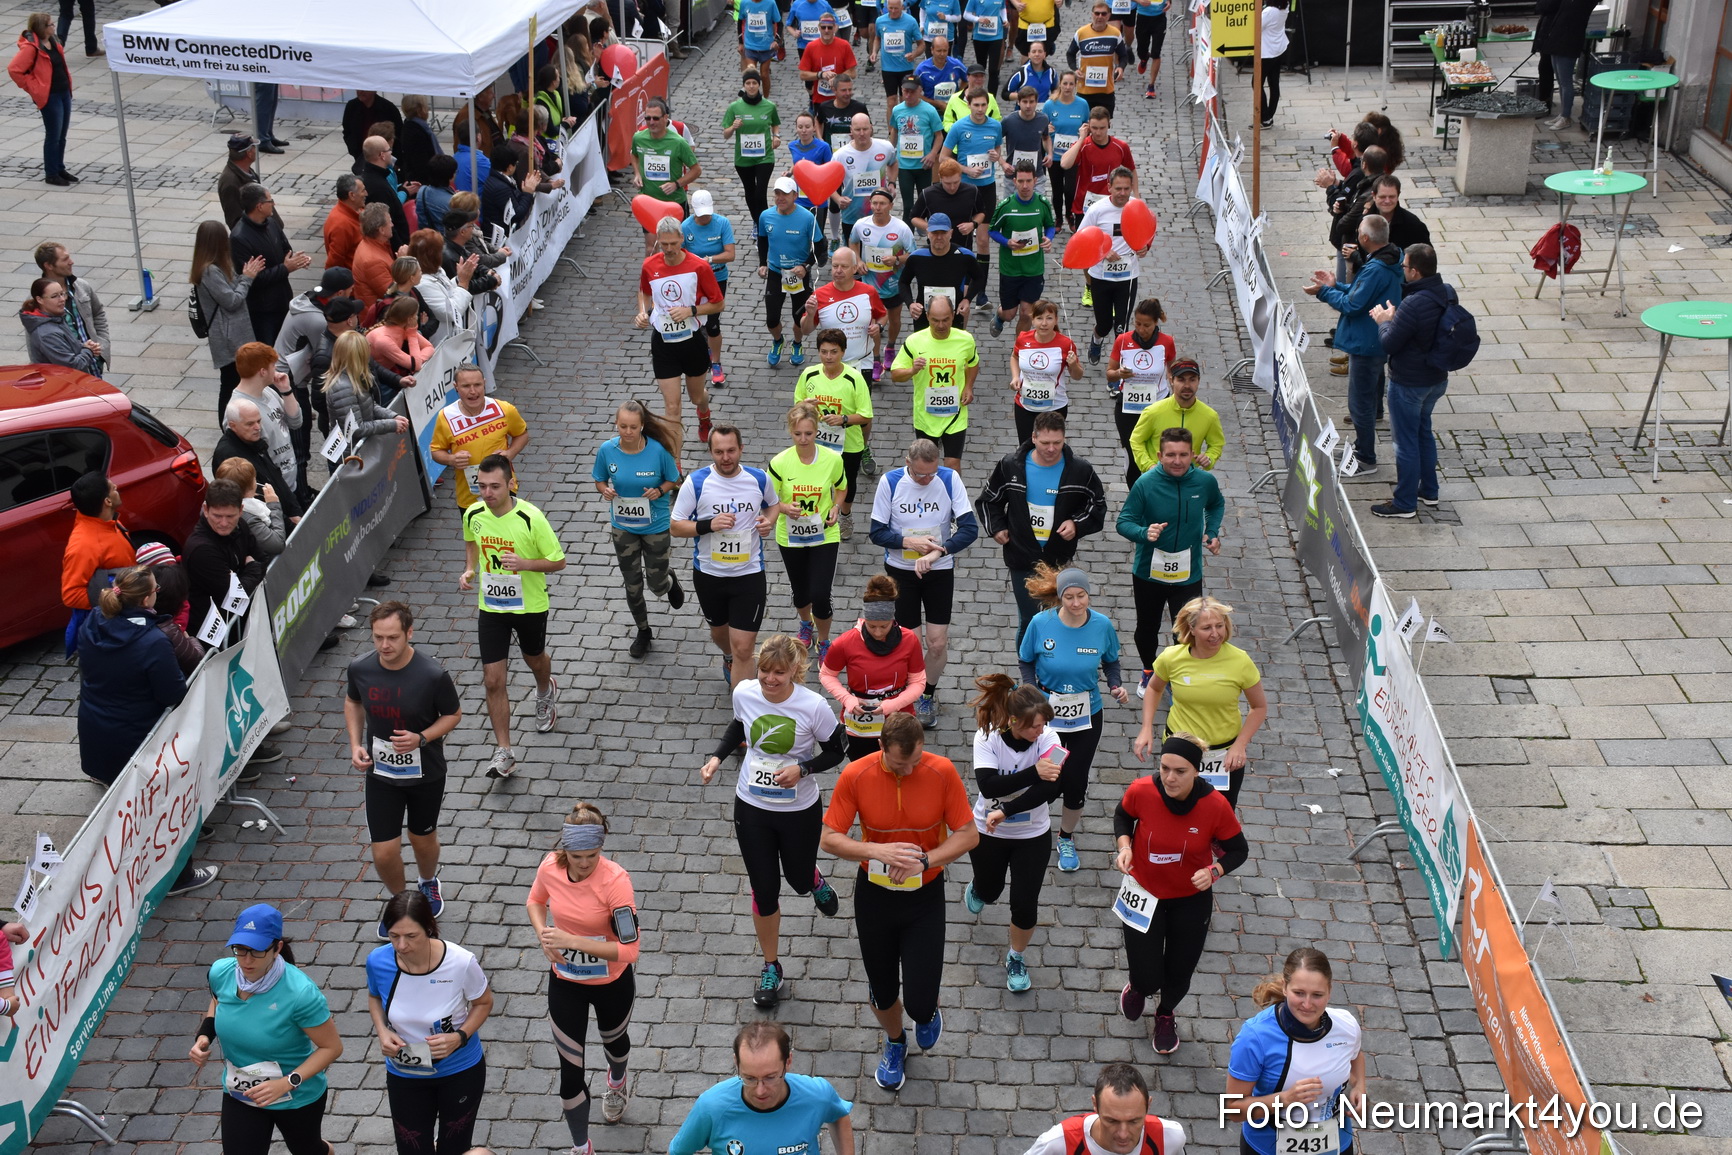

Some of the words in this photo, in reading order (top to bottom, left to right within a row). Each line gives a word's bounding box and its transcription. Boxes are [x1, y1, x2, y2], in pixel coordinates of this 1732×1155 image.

[1213, 2, 1255, 15] Jugend
[1226, 15, 1248, 27] lauf
[122, 34, 170, 52] BMW
[175, 38, 313, 62] ConnectedDrive
[125, 52, 180, 69] Vernetzt,
[182, 60, 201, 68] um
[203, 58, 224, 70] frei
[225, 63, 240, 72] zu
[242, 62, 271, 74] sein.
[647, 163, 666, 172] 2555
[857, 179, 877, 187] 2589
[784, 276, 798, 284] 198
[663, 321, 686, 332] 2173
[1297, 331, 1306, 348] swn
[936, 372, 950, 383] M
[814, 395, 842, 403] Müller
[1026, 389, 1050, 399] 2338
[1128, 392, 1151, 402] 2914
[930, 396, 955, 406] 2598
[455, 432, 479, 446] MAX
[480, 421, 508, 437] BÖGL
[816, 430, 840, 443] 2417
[327, 438, 341, 456] swn
[617, 506, 644, 516] 2440
[712, 498, 754, 514] SUSPA
[900, 498, 940, 518] SUSPA
[791, 524, 818, 535] 2045
[481, 536, 514, 546] Müller
[720, 542, 741, 553] 211
[1163, 562, 1178, 571] 58
[274, 552, 323, 642] BOCK
[487, 584, 516, 597] 2046
[207, 617, 221, 640] swn
[1063, 684, 1075, 693] 18.
[1054, 704, 1085, 717] 2237
[254, 716, 270, 739] GmbH
[379, 751, 413, 765] 2488
[1198, 761, 1222, 772] 047
[756, 770, 780, 786] 255
[20, 884, 34, 912] swn
[1121, 886, 1148, 912] 2481
[50, 854, 102, 956] UNS
[566, 965, 591, 976] Hanna
[69, 976, 118, 1061] Service-Line:
[1509, 1010, 1518, 1024] für
[1515, 1024, 1525, 1041] die
[1518, 1006, 1542, 1056] Neumarkts
[396, 1049, 422, 1065] 422
[1286, 1135, 1330, 1153] 2431
